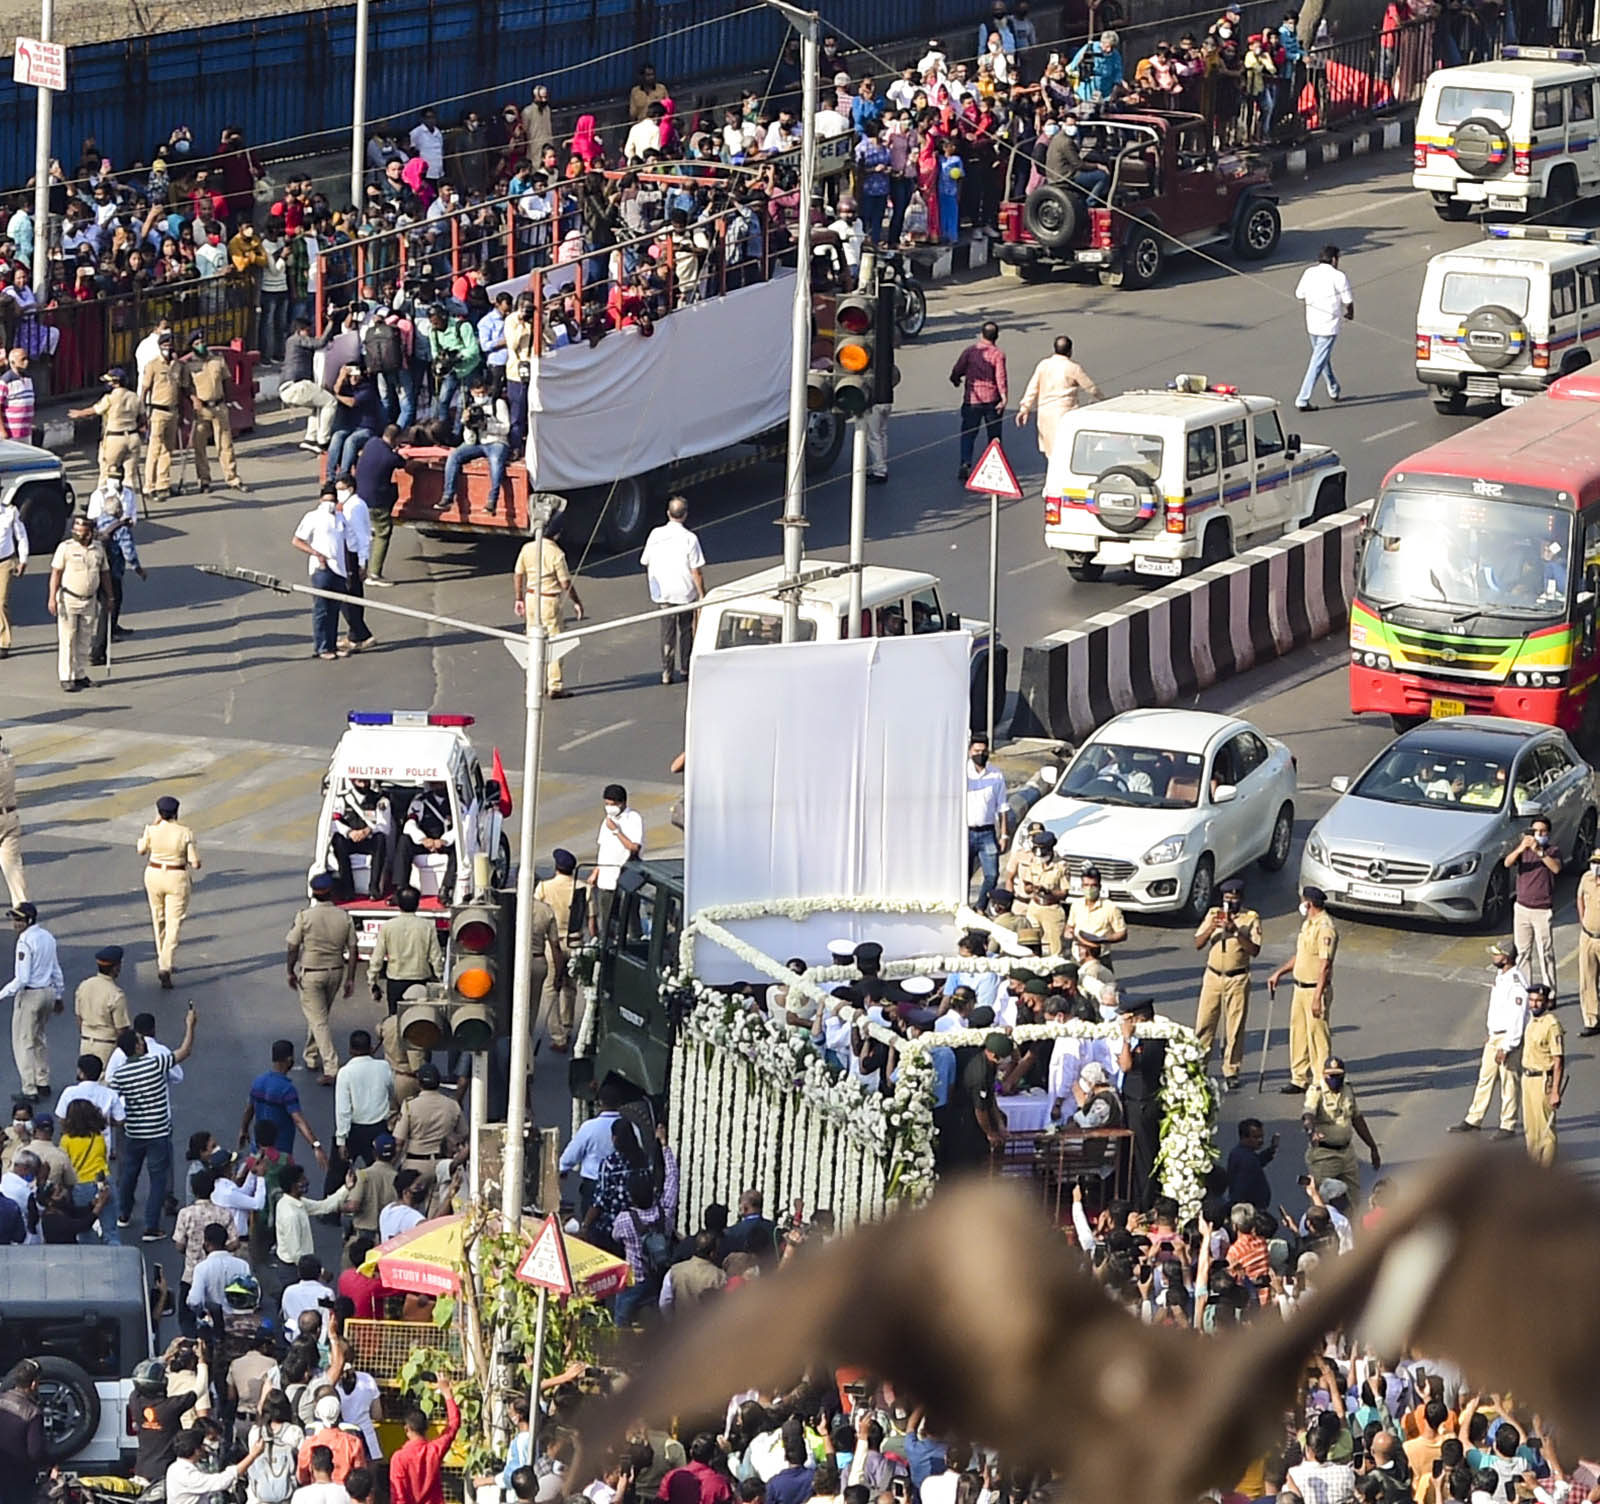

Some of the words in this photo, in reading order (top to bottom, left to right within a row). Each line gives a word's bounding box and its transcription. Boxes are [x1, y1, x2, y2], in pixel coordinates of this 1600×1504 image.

[348, 766, 394, 776] MILITARY
[405, 767, 437, 777] POLICE
[391, 1268, 418, 1282] STUDY
